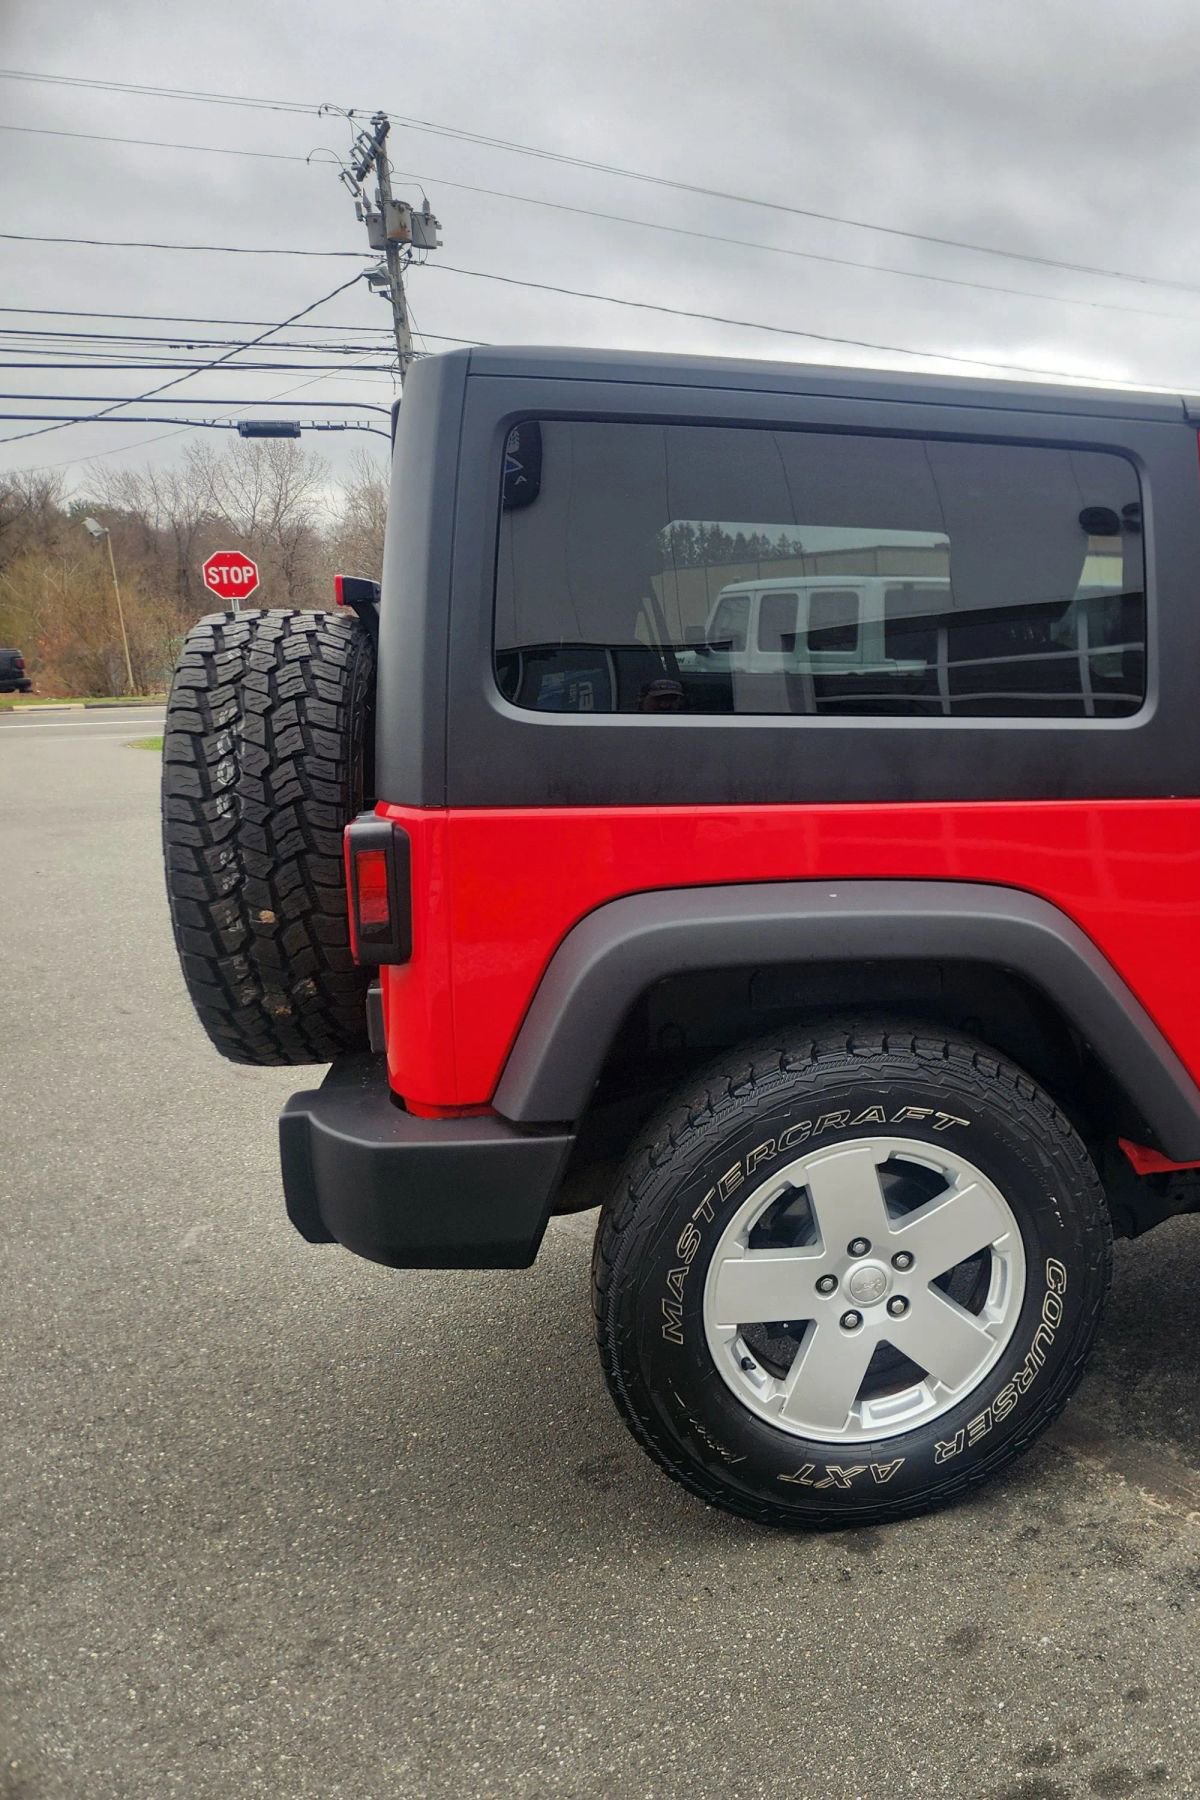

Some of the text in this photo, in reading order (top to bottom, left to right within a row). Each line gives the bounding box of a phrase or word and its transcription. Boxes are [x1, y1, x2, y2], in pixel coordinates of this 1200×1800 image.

[208, 566, 254, 584] STOP
[662, 1105, 971, 1345] MASTERCRAFT
[777, 1258, 1067, 1489] COURSER AXT
